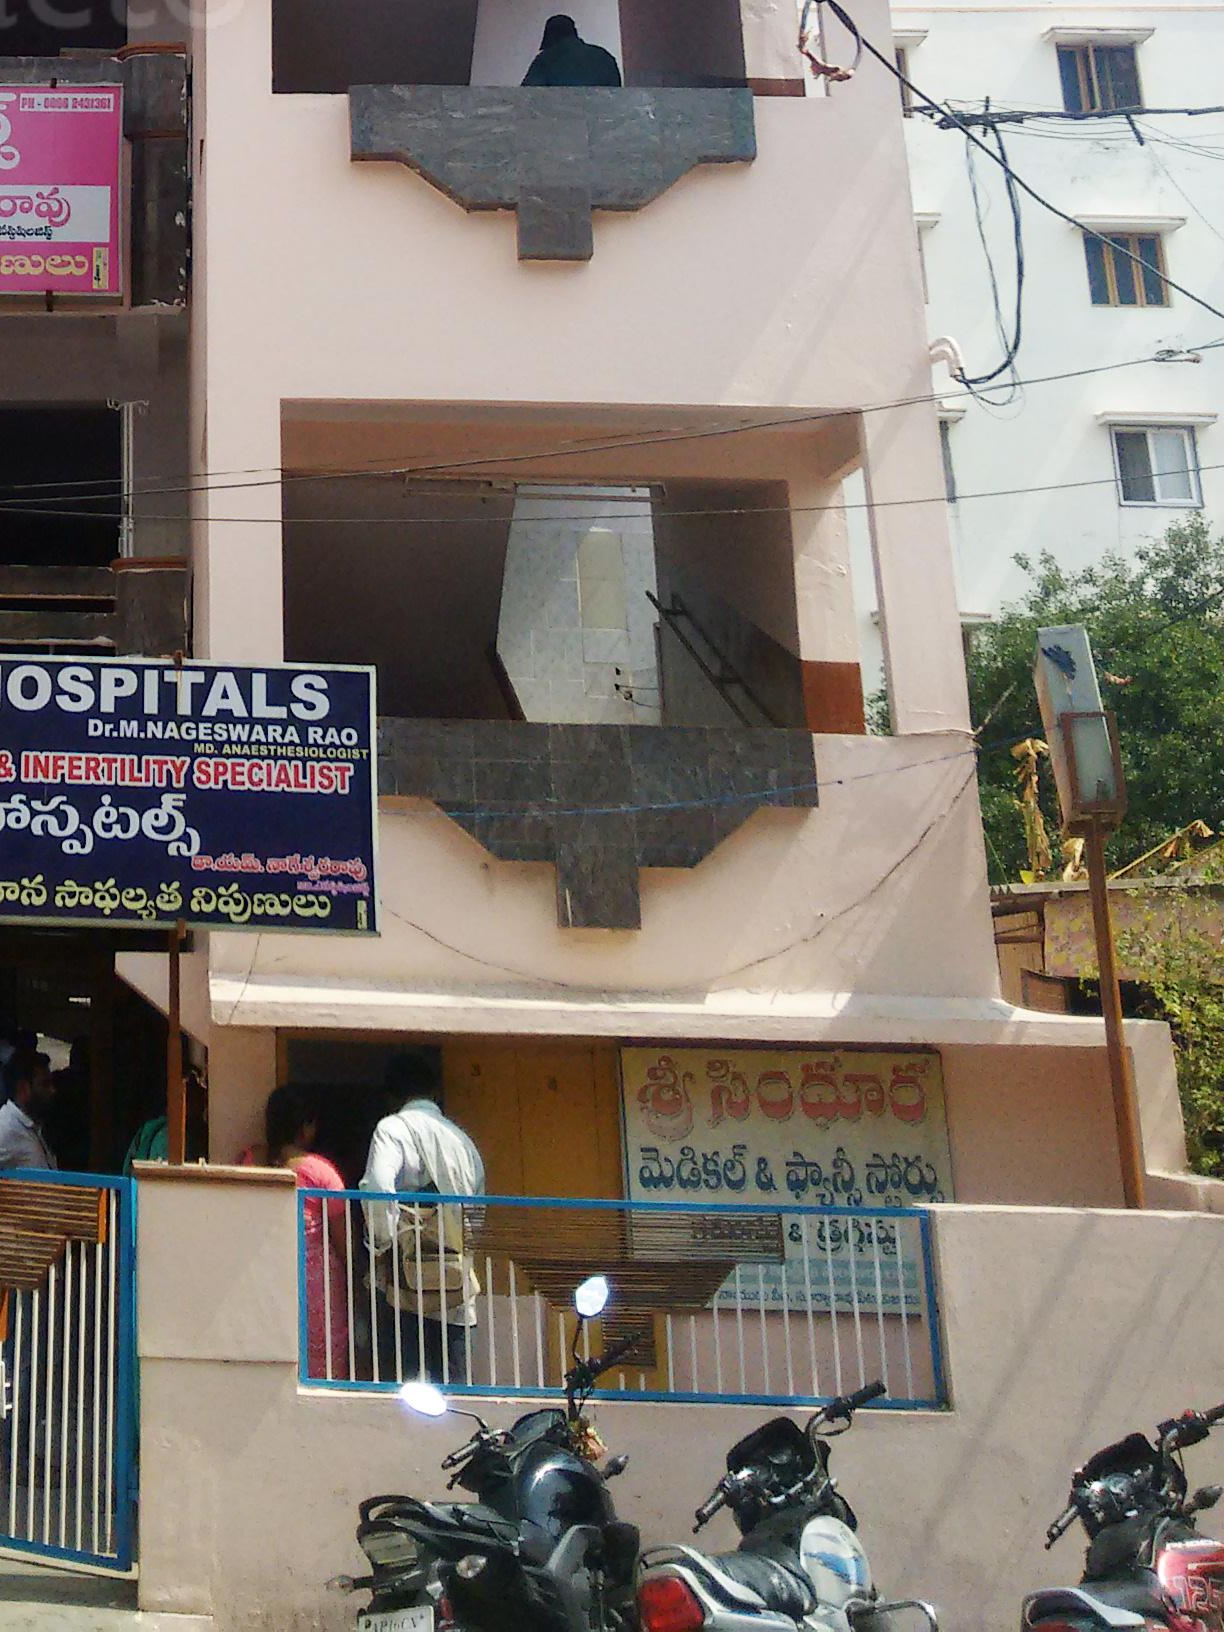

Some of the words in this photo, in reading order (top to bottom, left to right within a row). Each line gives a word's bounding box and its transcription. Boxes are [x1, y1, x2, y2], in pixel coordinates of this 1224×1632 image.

[88, 718, 299, 745] Dr.M.NAGESWARA
[307, 726, 359, 747] RAO
[222, 743, 369, 760] ANAESTHESIOLOGIST
[20, 750, 188, 789] INFERTILITY
[194, 758, 356, 796] SPECIALIST
[189, 882, 332, 924] నిపుణులు
